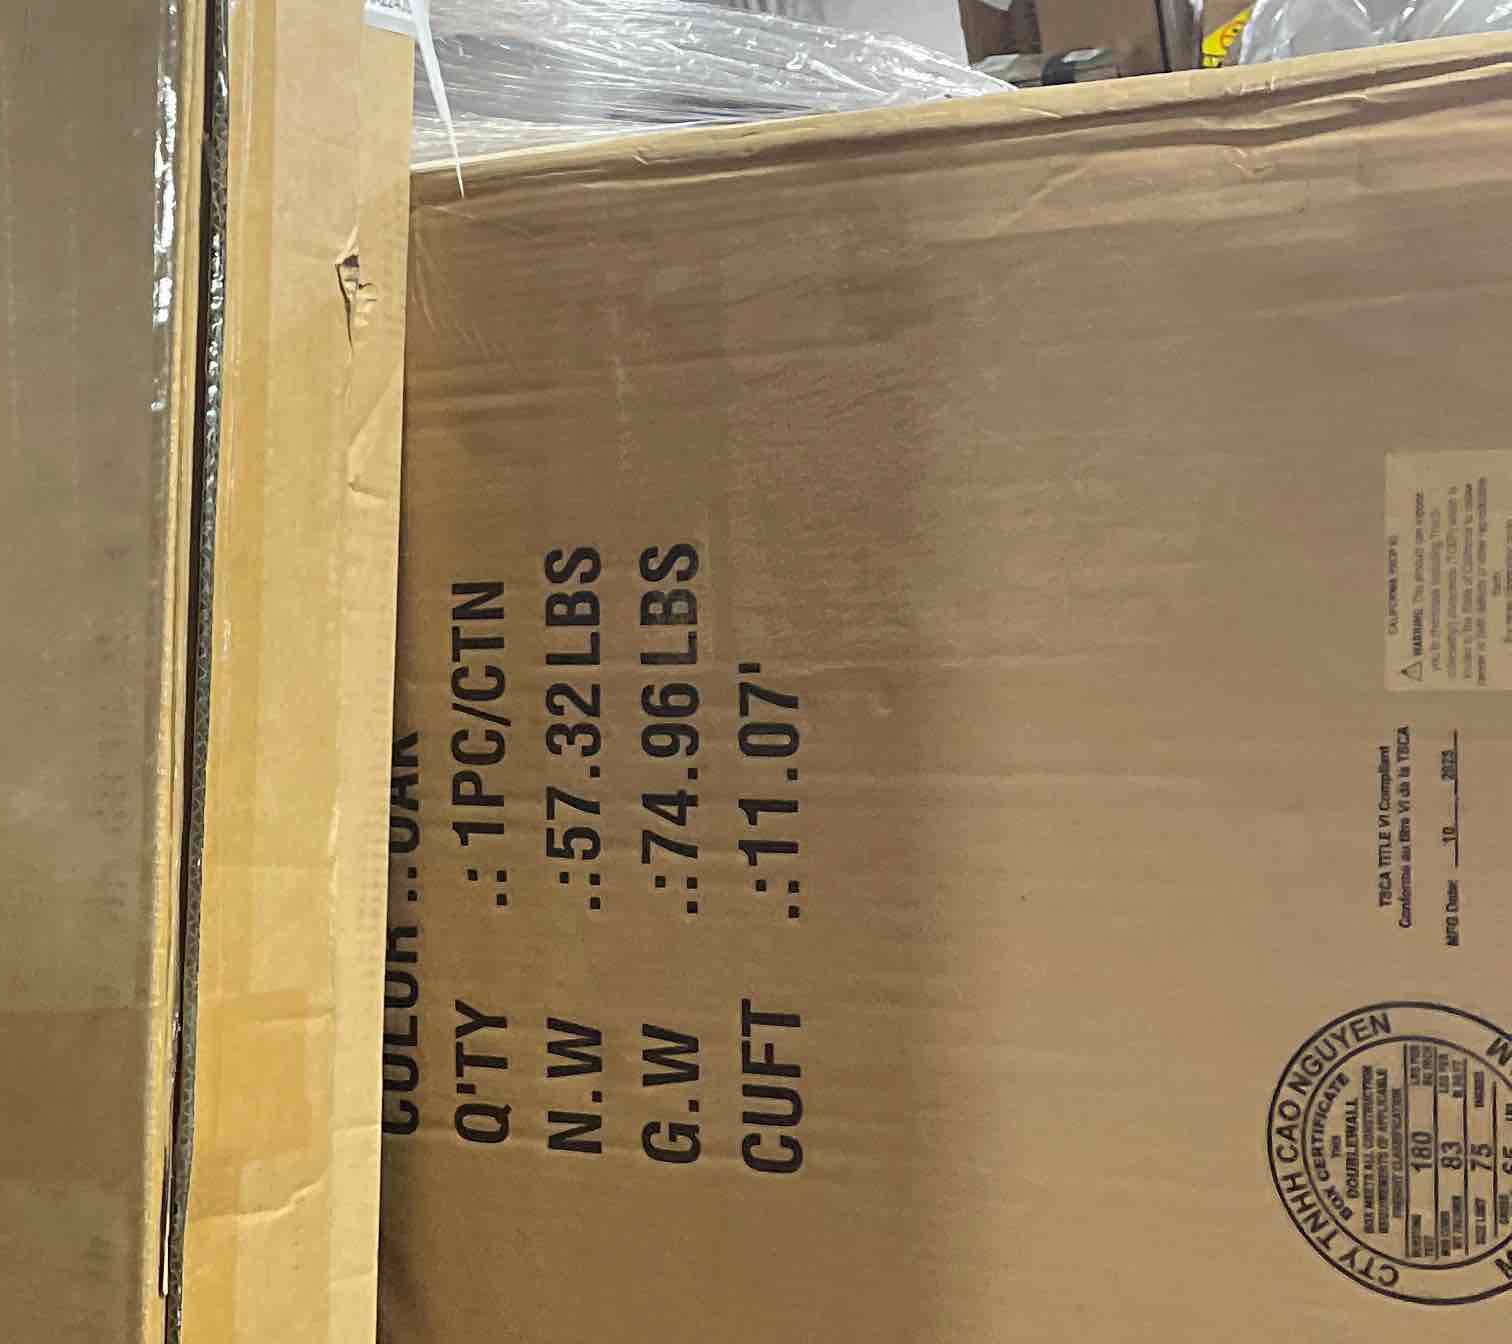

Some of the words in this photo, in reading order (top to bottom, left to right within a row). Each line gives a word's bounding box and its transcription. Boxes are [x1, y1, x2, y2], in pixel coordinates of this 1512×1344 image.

[544, 546, 601, 667] LBS
[639, 543, 699, 667] LBS
[451, 581, 511, 847] 1PC/CTN
[454, 999, 513, 1144] Q'TY
[546, 1016, 602, 1155] N.W
[641, 1023, 700, 1164] G.W
[741, 998, 803, 1174] CUFT
[1288, 1012, 1392, 1095] NGUYEN
[1274, 1100, 1301, 1164] CAO
[1311, 1071, 1350, 1182] CERTIFICATE
[1410, 1131, 1433, 1174] 180
[1440, 1140, 1462, 1170] 83
[1470, 1143, 1493, 1172] 75
[1285, 1171, 1340, 1250] TNHH
[1339, 1246, 1400, 1288] CTY
